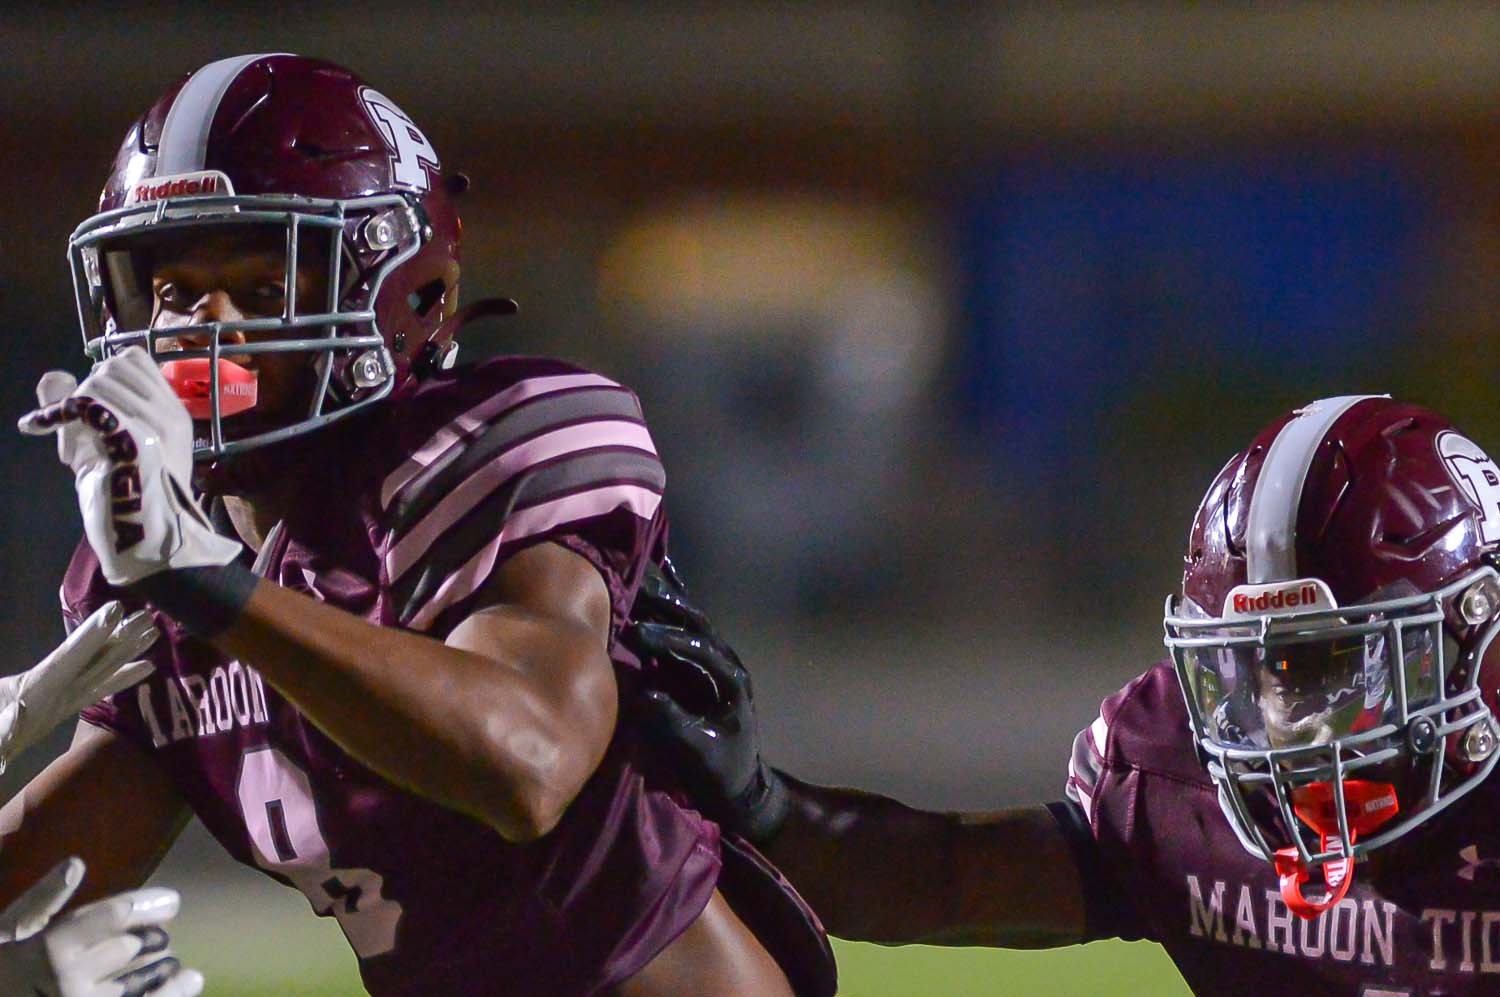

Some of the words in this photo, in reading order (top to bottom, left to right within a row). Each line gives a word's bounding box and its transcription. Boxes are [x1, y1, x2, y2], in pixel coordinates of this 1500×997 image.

[1233, 584, 1317, 613] Riddell
[237, 747, 402, 958] 8
[1186, 875, 1397, 966] MAROON
